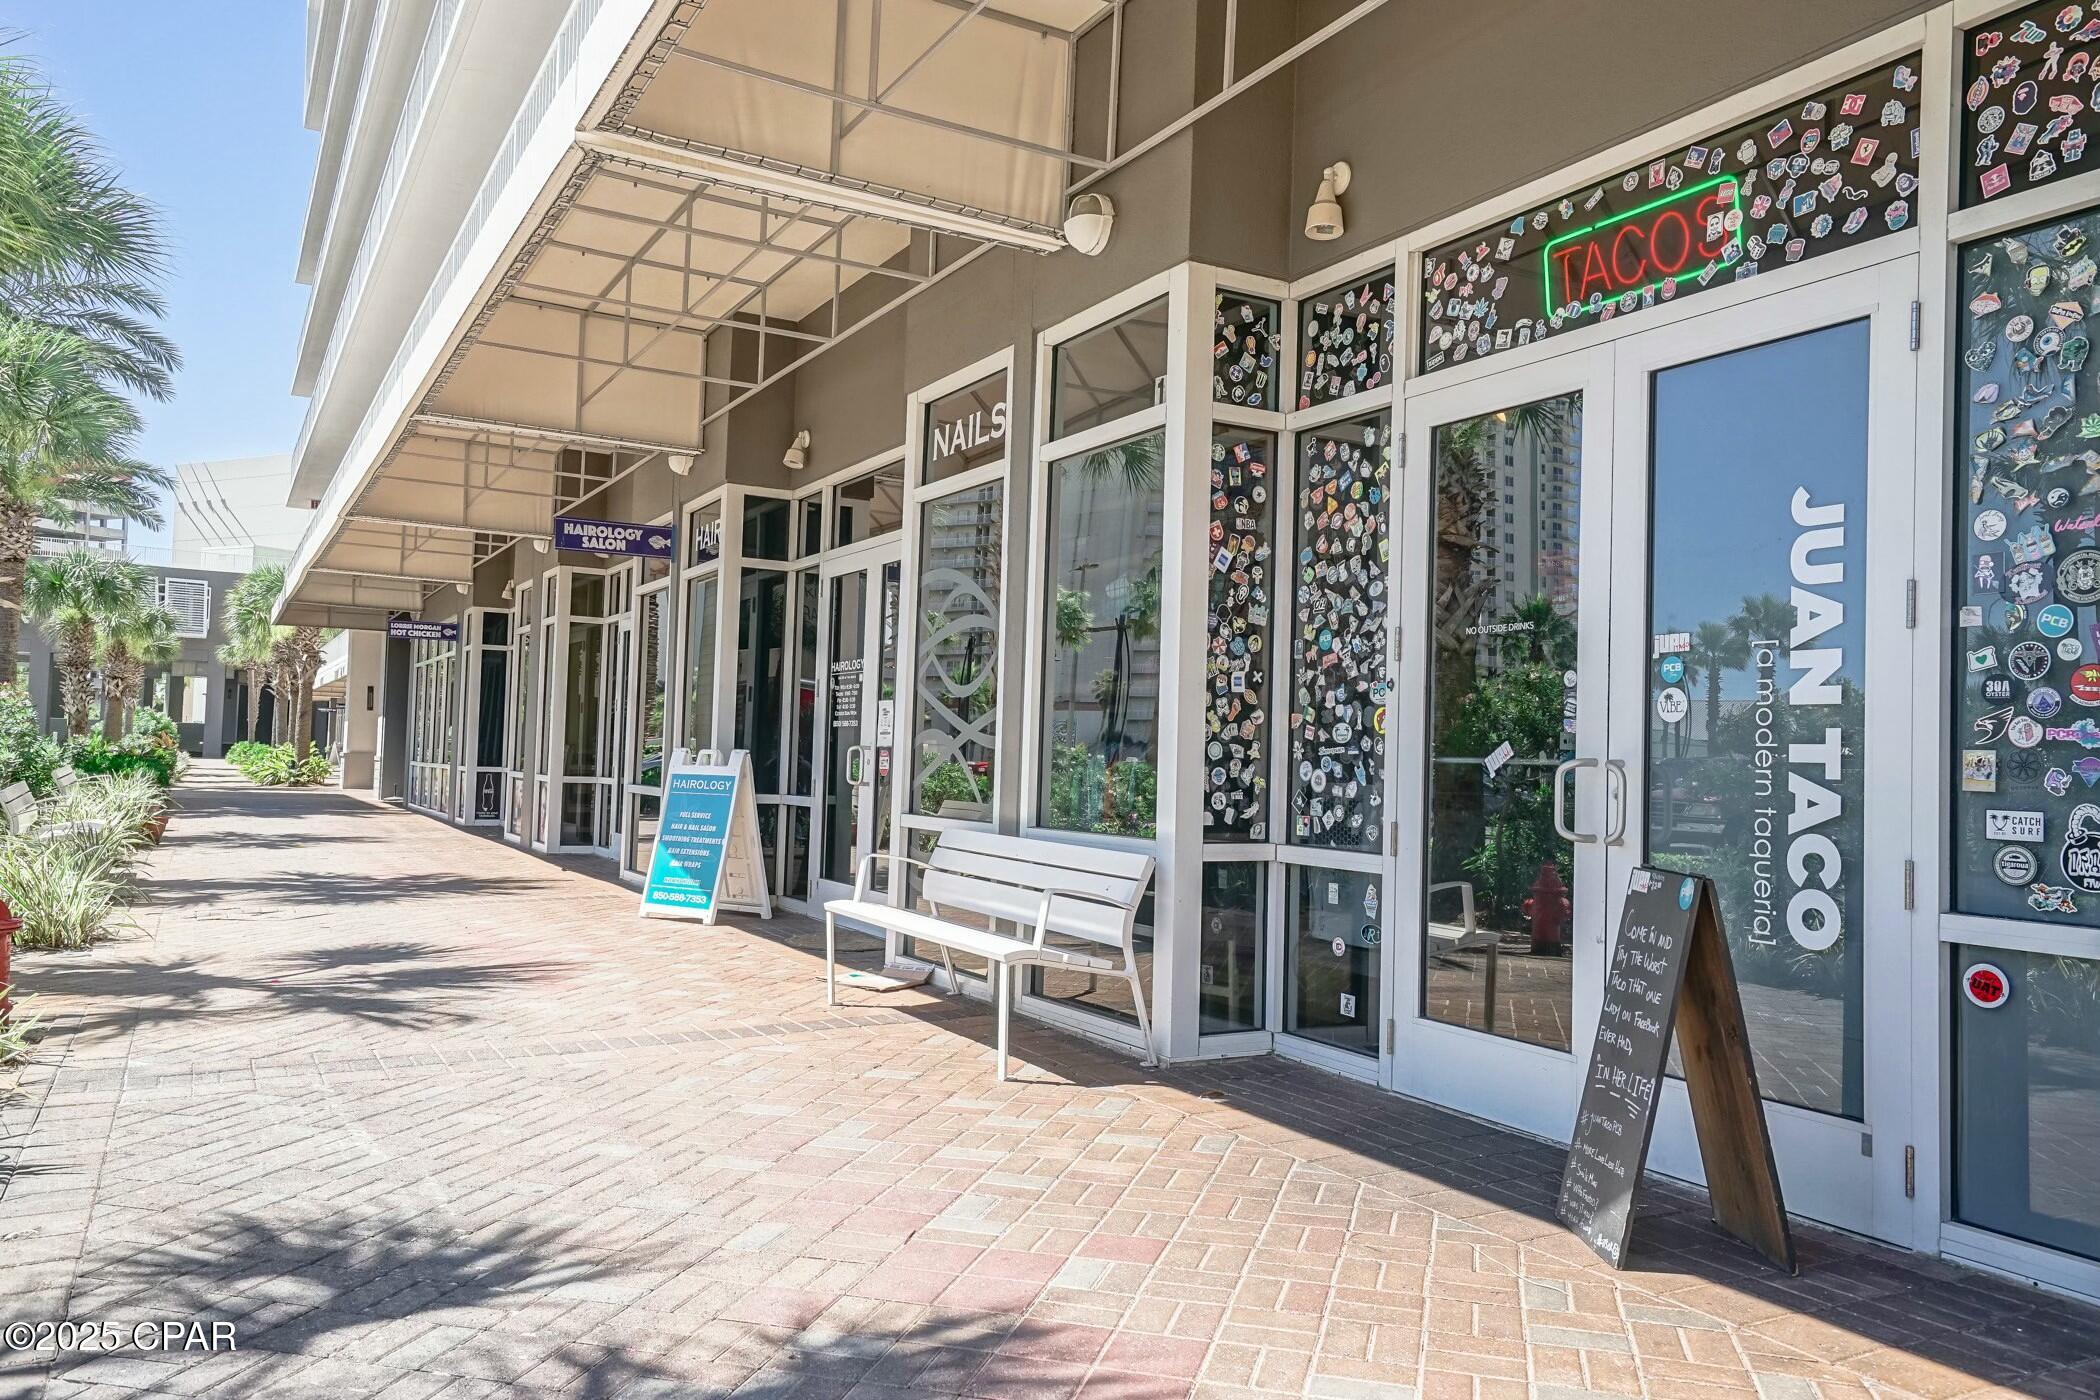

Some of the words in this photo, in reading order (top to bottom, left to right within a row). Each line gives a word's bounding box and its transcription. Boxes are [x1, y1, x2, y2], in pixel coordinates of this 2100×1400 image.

[1552, 196, 1729, 303] TACOS
[932, 402, 1007, 461] NAILS
[564, 523, 643, 541] HAIROLOGY
[582, 536, 627, 551] SALON
[1789, 486, 1845, 705] JUAN
[1465, 626, 1477, 635] NO
[1478, 623, 1507, 634] OUTSIDE
[1508, 621, 1535, 632] DRINKS
[2041, 613, 2069, 629] PCB
[408, 630, 441, 638] CHICKEN
[831, 659, 864, 673] HAIROLOGY
[1985, 680, 2011, 692] 30A
[1755, 679, 1778, 796] modern
[672, 779, 732, 791] HAIROLOGY
[700, 824, 716, 832] SALON
[2012, 816, 2041, 826] CATCH
[2012, 826, 2041, 836] SURF
[1786, 728, 1842, 951] TACO
[1749, 807, 1777, 945] taqueria]
